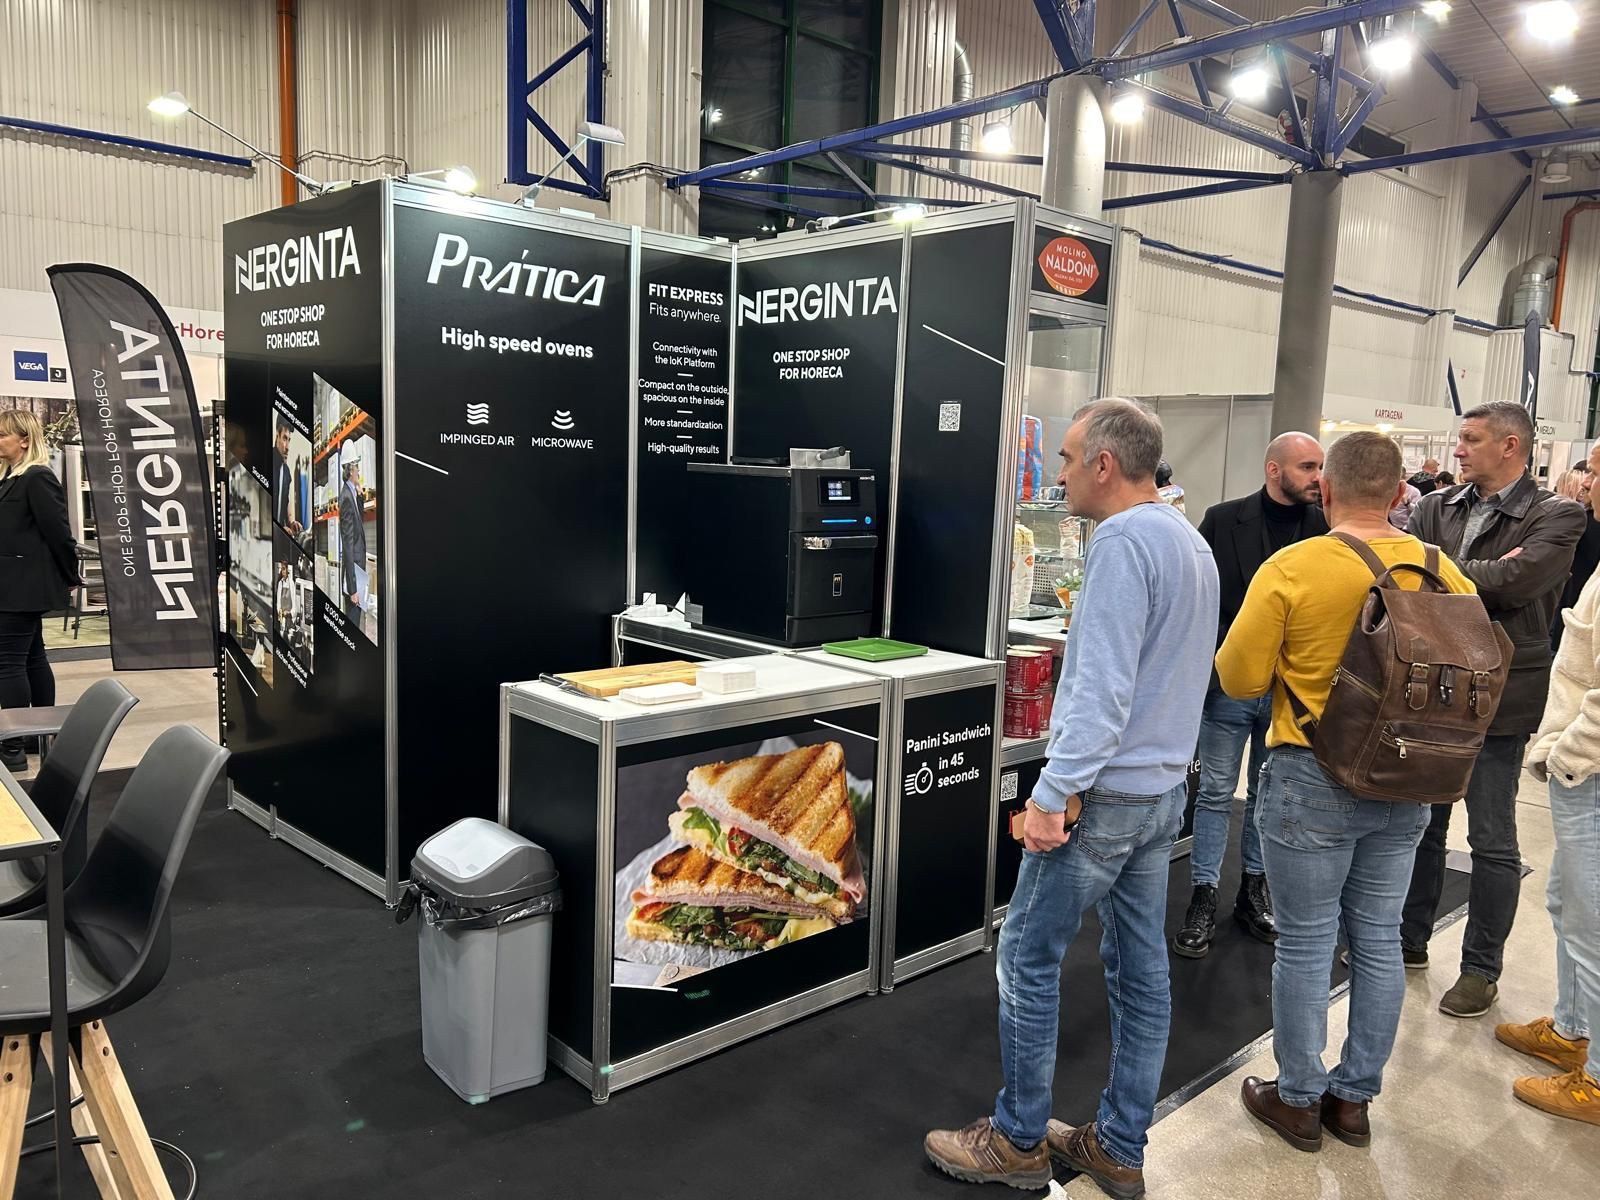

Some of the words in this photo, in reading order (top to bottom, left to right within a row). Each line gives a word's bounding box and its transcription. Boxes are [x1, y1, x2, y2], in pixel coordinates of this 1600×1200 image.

[1056, 244, 1087, 259] MOLINO
[235, 225, 361, 295] NERGINTA
[1046, 253, 1094, 279] NALDONI
[427, 233, 606, 307] PRÁTICA
[649, 283, 668, 298] FIT
[670, 286, 724, 306] EXPRESS
[738, 276, 898, 326] NERGINTA
[260, 309, 278, 327] ONE
[278, 306, 300, 325] STOP
[300, 304, 325, 323] SHOP
[650, 302, 669, 316] Fits
[671, 308, 722, 322] anywhere.
[266, 333, 283, 350] FOR
[284, 330, 320, 349] HORECA
[441, 327, 486, 350] High
[489, 337, 542, 354] speed
[545, 343, 594, 359] ovens
[653, 341, 701, 357] Connectivity
[702, 348, 718, 357] with
[773, 351, 794, 363] ONE
[795, 349, 821, 362] STOP
[822, 348, 850, 361] SHOP
[18, 361, 45, 371] VEGA
[655, 355, 668, 364] the
[684, 357, 716, 368] Platform
[779, 368, 799, 380] FOR
[800, 366, 843, 379] HORECA
[639, 378, 674, 391] Compact
[687, 383, 700, 392] the
[643, 393, 677, 403] spacious
[690, 395, 702, 404] the
[703, 396, 725, 406] inside
[1375, 409, 1403, 419] KARTAGENA
[644, 417, 665, 427] More
[667, 418, 723, 430] standardization
[440, 433, 496, 446] IMPINGED
[497, 435, 515, 446] AIR
[532, 437, 594, 449] MICROWAVE
[648, 442, 695, 455] High-quality
[695, 445, 719, 454] results
[906, 733, 941, 754] Panini
[942, 723, 991, 746] Sandwich
[938, 757, 949, 770] in
[950, 752, 964, 766] 45
[938, 767, 980, 788] seconds
